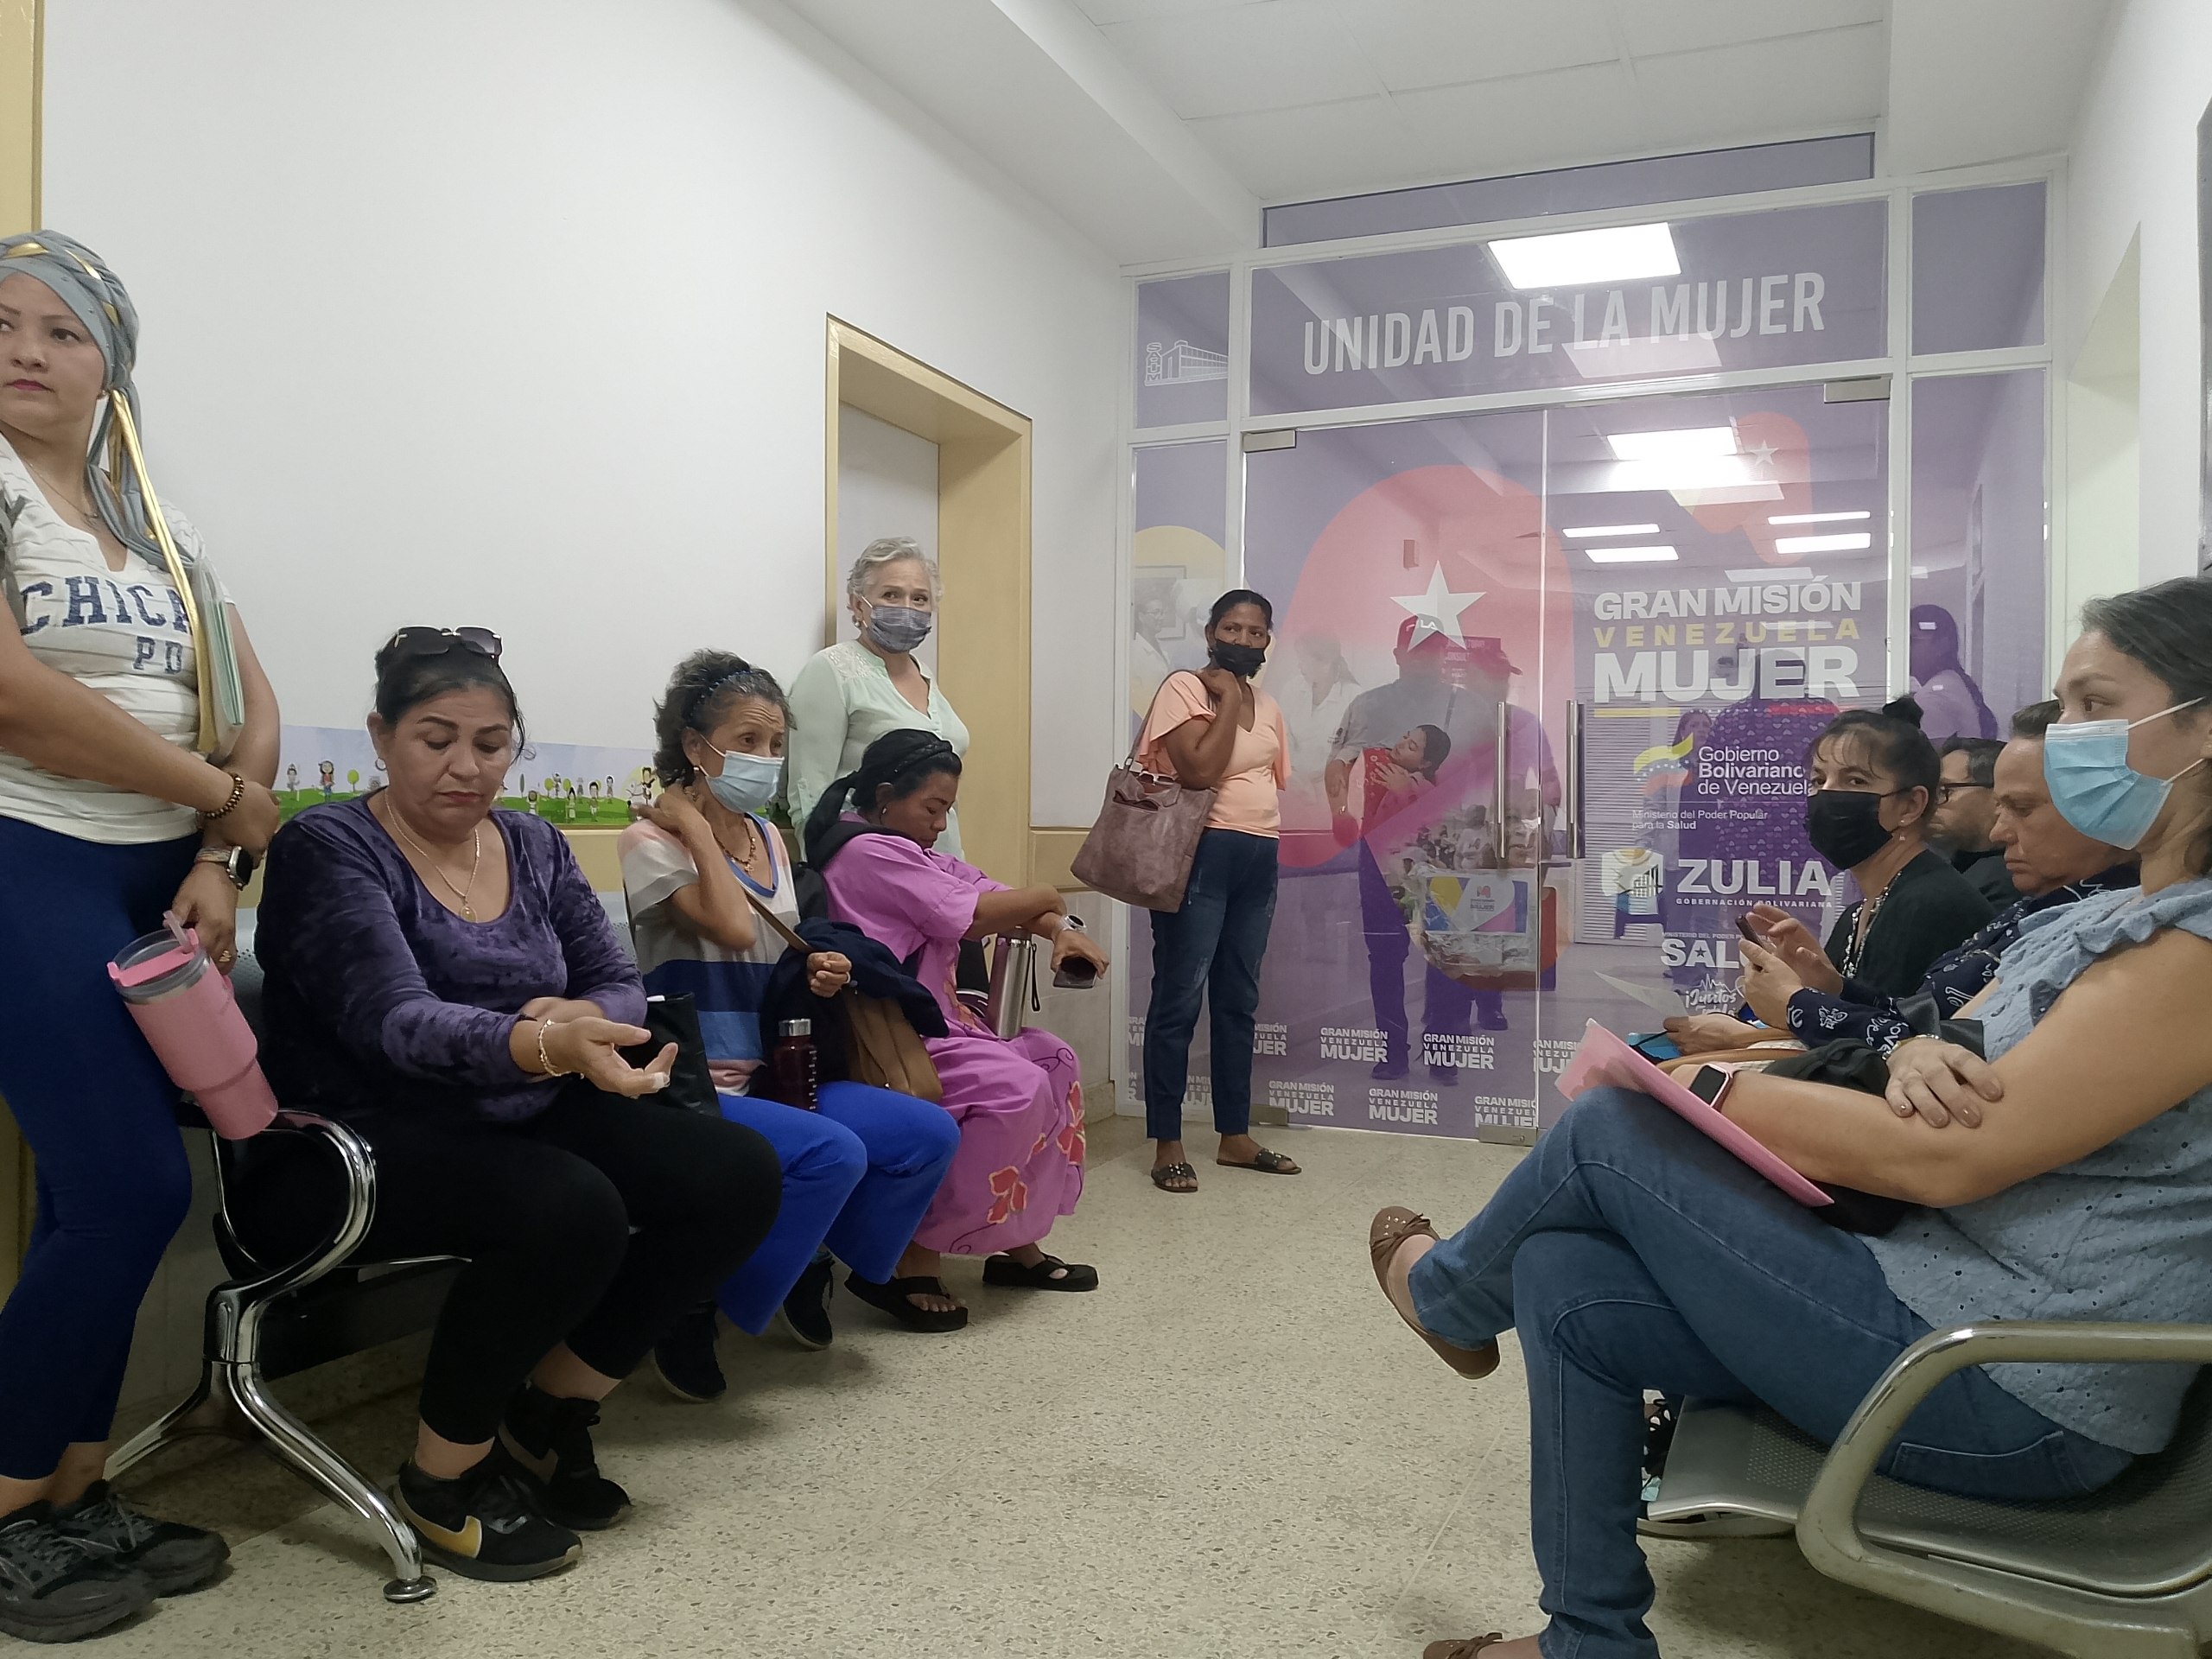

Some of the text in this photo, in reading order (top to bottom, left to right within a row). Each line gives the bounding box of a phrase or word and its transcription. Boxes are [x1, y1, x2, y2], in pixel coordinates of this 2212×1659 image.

[1303, 271, 1826, 375] UNIDAD DE LA MUJER
[1593, 575, 1862, 620] GRAN MISIÓN
[1593, 617, 1861, 649] VENEZUELA
[1593, 645, 1861, 702] MUJER
[1698, 746, 1780, 762] Gobierno
[1697, 779, 1720, 795] de
[1632, 810, 1769, 821] Ministerio del Poder Popular
[1666, 820, 1697, 830] Salud
[1676, 859, 1833, 896] ZULIA
[1675, 898, 1753, 907] GOBERNACIÓN
[1660, 938, 1747, 969] SAL
[1320, 1027, 1389, 1039] GRAN MISIÓN
[1423, 1033, 1495, 1046] GRAN MISIÓN
[1320, 1036, 1389, 1047] VENEZUELA
[1320, 1045, 1389, 1063] MUJER
[1423, 1043, 1494, 1054] VENEZUELA
[1424, 1050, 1495, 1070] MUJER
[1268, 1080, 1335, 1093] GRAN MISIÓN
[1268, 1090, 1334, 1102] VENEZUELA
[1369, 1089, 1439, 1102] GRAN MISIÓN
[1474, 1096, 1506, 1106] GRAN
[1268, 1096, 1335, 1116] MUJER
[1369, 1097, 1438, 1109] VENEZUELA
[1369, 1104, 1439, 1125] MUJER
[1474, 1106, 1537, 1116] VENEZUEL
